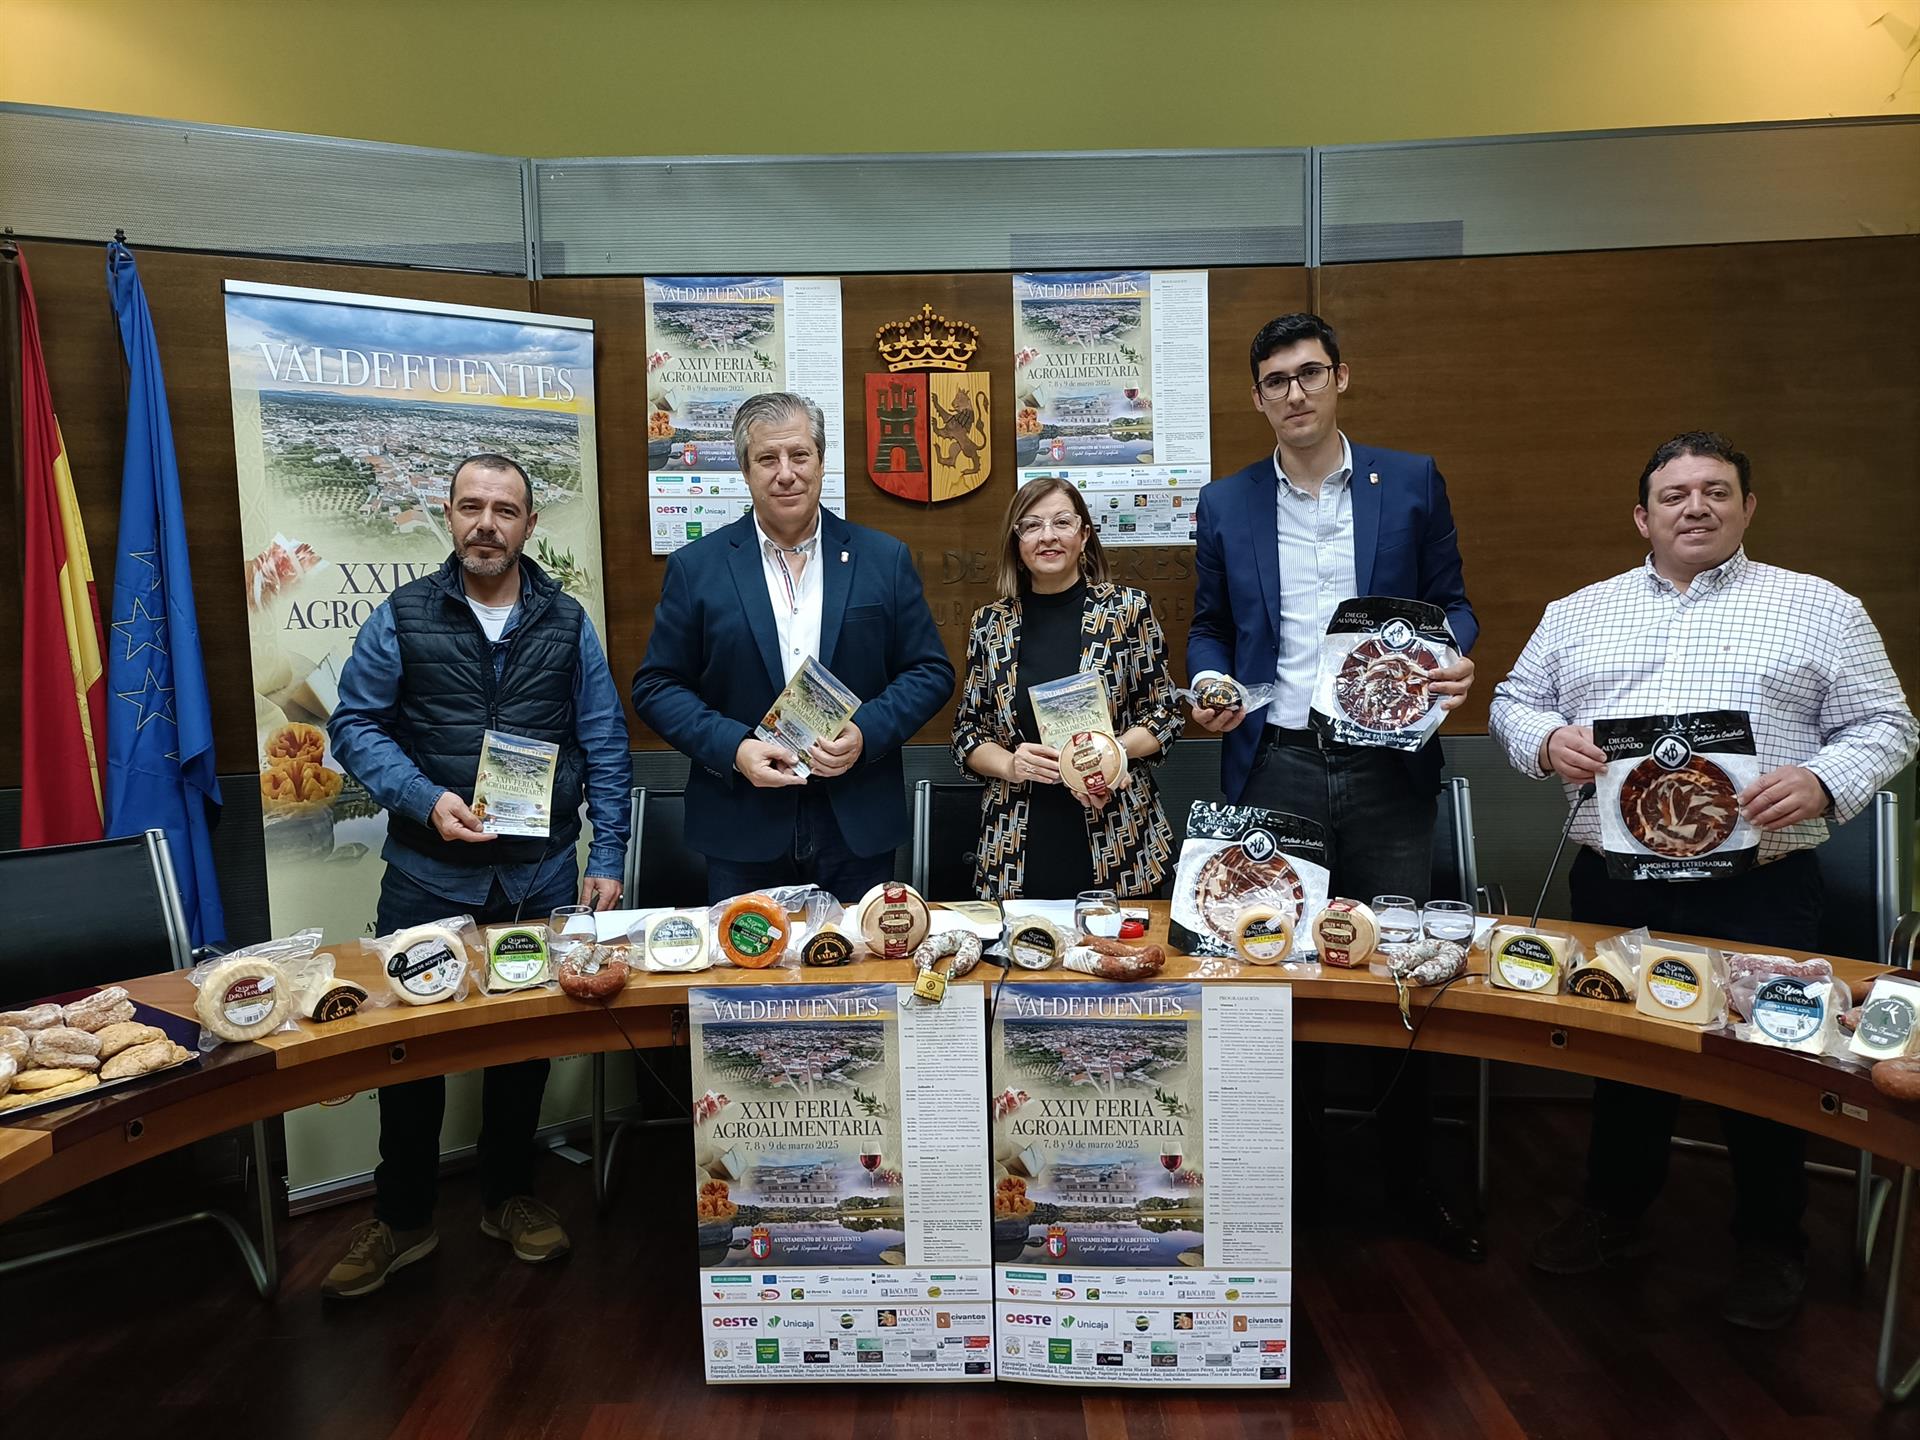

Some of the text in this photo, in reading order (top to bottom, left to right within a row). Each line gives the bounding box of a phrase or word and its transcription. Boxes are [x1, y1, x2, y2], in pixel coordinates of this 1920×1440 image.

[660, 288, 771, 300] VALDEFUENTES
[1028, 282, 1138, 298] VALDEFUENTES
[679, 358, 754, 370] XXIV FERIA
[1046, 352, 1120, 366] XXIV FERIA
[256, 342, 575, 402] VALDEFUENTES
[660, 372, 773, 383] AGROALIMENTARIA
[1027, 366, 1140, 380] AGROALIMENTARIA
[704, 508, 726, 516] Unicaja
[1601, 742, 1643, 752] ALVARADO
[712, 997, 880, 1020] VALDEFUENTES
[1015, 996, 1184, 1018] VALDEFUENTES
[740, 1100, 853, 1120] XXIV FERIA
[1040, 1100, 1153, 1117] XXIV FERIA
[713, 1120, 882, 1139] AGROALIMENTARIA
[1012, 1119, 1184, 1136] AGROALIMENTARIA
[754, 1141, 760, 1150] 8
[761, 1144, 766, 1152] y
[768, 1141, 775, 1150] 9
[776, 1141, 786, 1150] de
[816, 1141, 839, 1150] 2025
[1053, 1140, 1059, 1148] 8
[1060, 1142, 1065, 1150] y
[1068, 1140, 1074, 1148] 9
[1076, 1140, 1085, 1148] de
[1116, 1140, 1139, 1148] 2025
[898, 1307, 931, 1316] TUCÁN
[1194, 1309, 1227, 1319] TUCÁN
[783, 1320, 814, 1329] Unicaja
[1077, 1320, 1108, 1330] Unicaja
